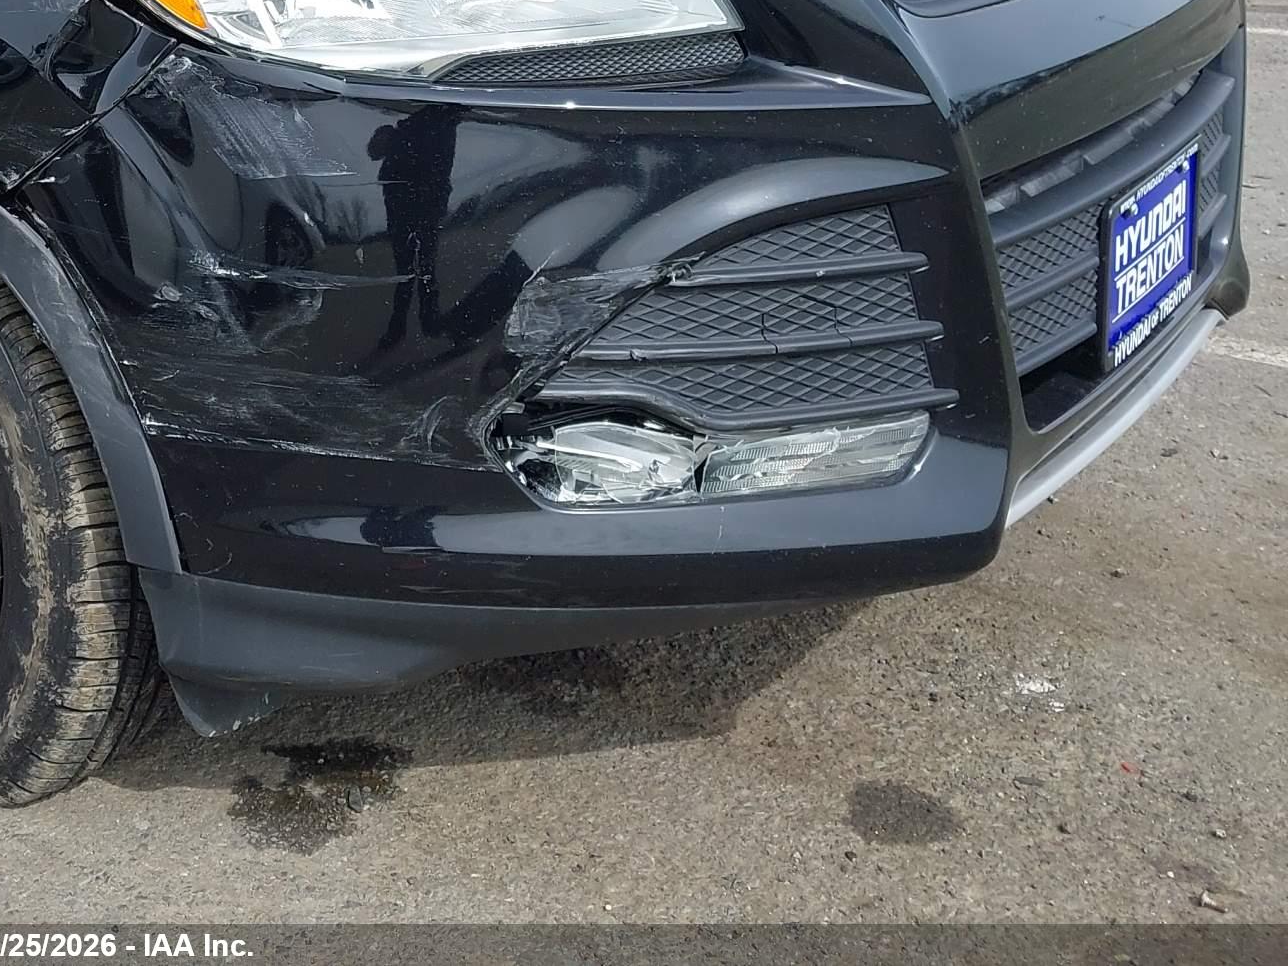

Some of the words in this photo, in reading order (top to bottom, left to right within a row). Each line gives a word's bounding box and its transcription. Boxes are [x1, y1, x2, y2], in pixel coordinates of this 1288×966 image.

[1114, 180, 1187, 272] HYUNDAI
[1115, 224, 1184, 315] TRENTON
[1114, 314, 1151, 367] HYUNDAI
[1159, 273, 1192, 323] TRENTON
